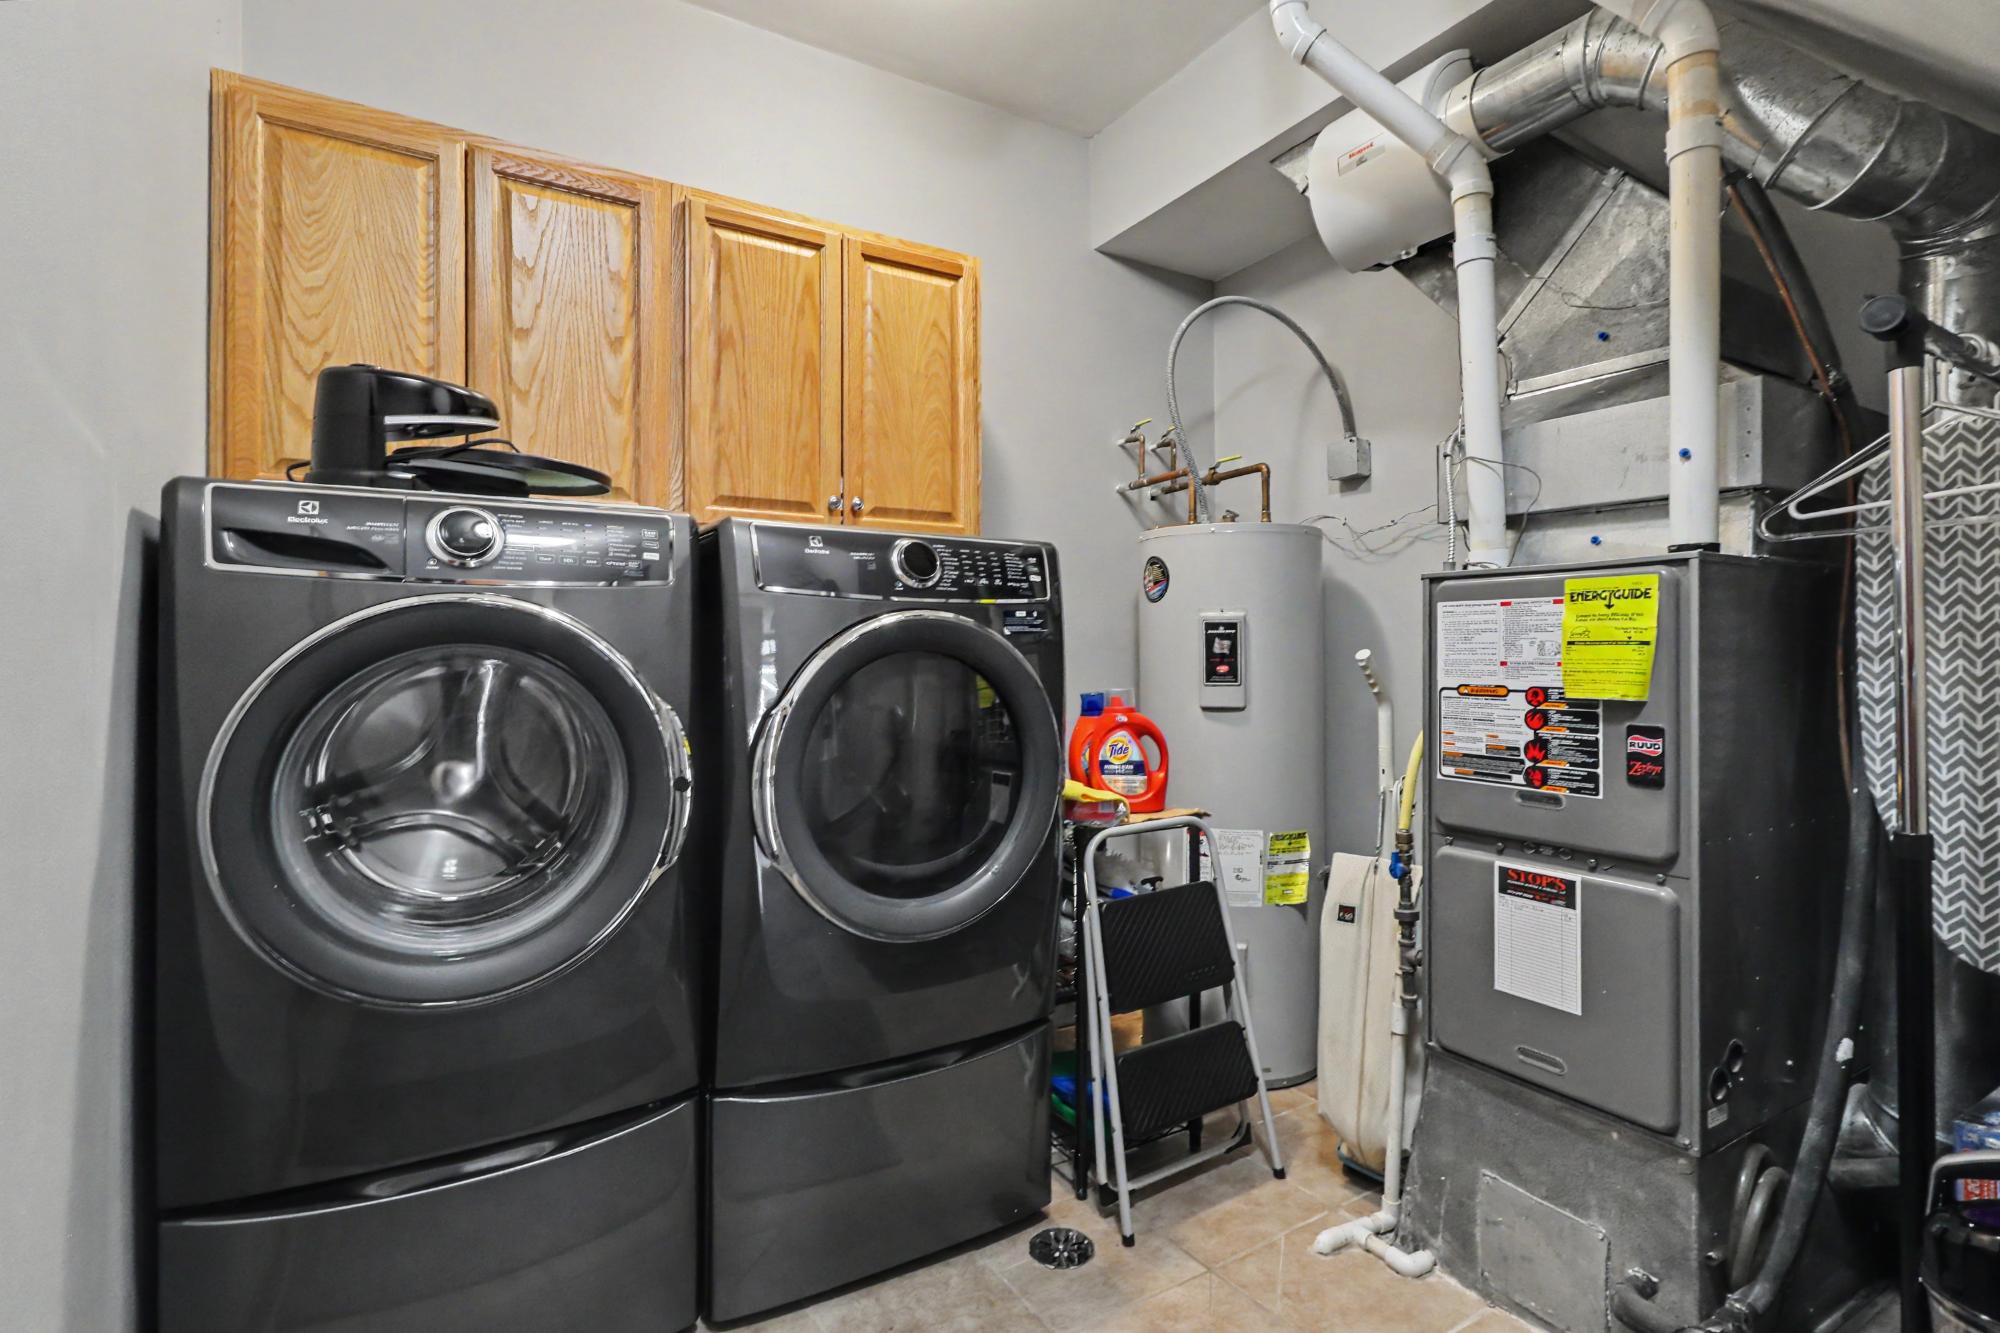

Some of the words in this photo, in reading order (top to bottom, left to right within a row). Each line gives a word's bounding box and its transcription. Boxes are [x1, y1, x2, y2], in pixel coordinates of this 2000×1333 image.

[287, 516, 329, 525] Electrolux
[1629, 741, 1661, 750] RUUD
[1108, 743, 1129, 758] Tide
